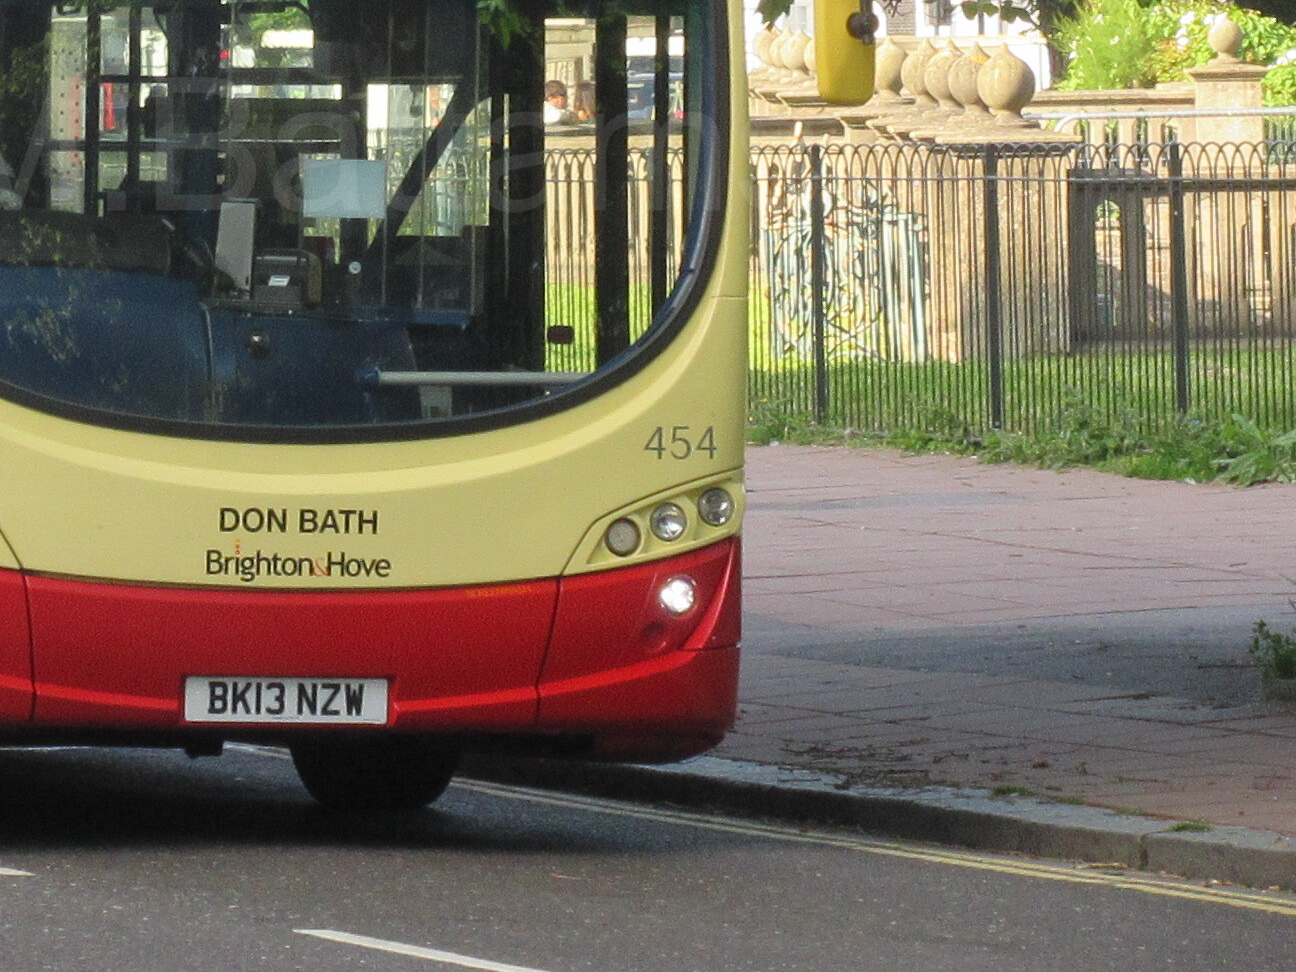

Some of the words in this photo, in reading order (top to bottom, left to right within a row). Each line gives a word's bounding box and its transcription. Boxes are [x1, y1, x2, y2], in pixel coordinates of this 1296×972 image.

[643, 425, 718, 461] 454
[219, 507, 288, 533] DON
[299, 508, 379, 535] BATH
[208, 680, 286, 715] BK13
[296, 682, 365, 716] NZW
